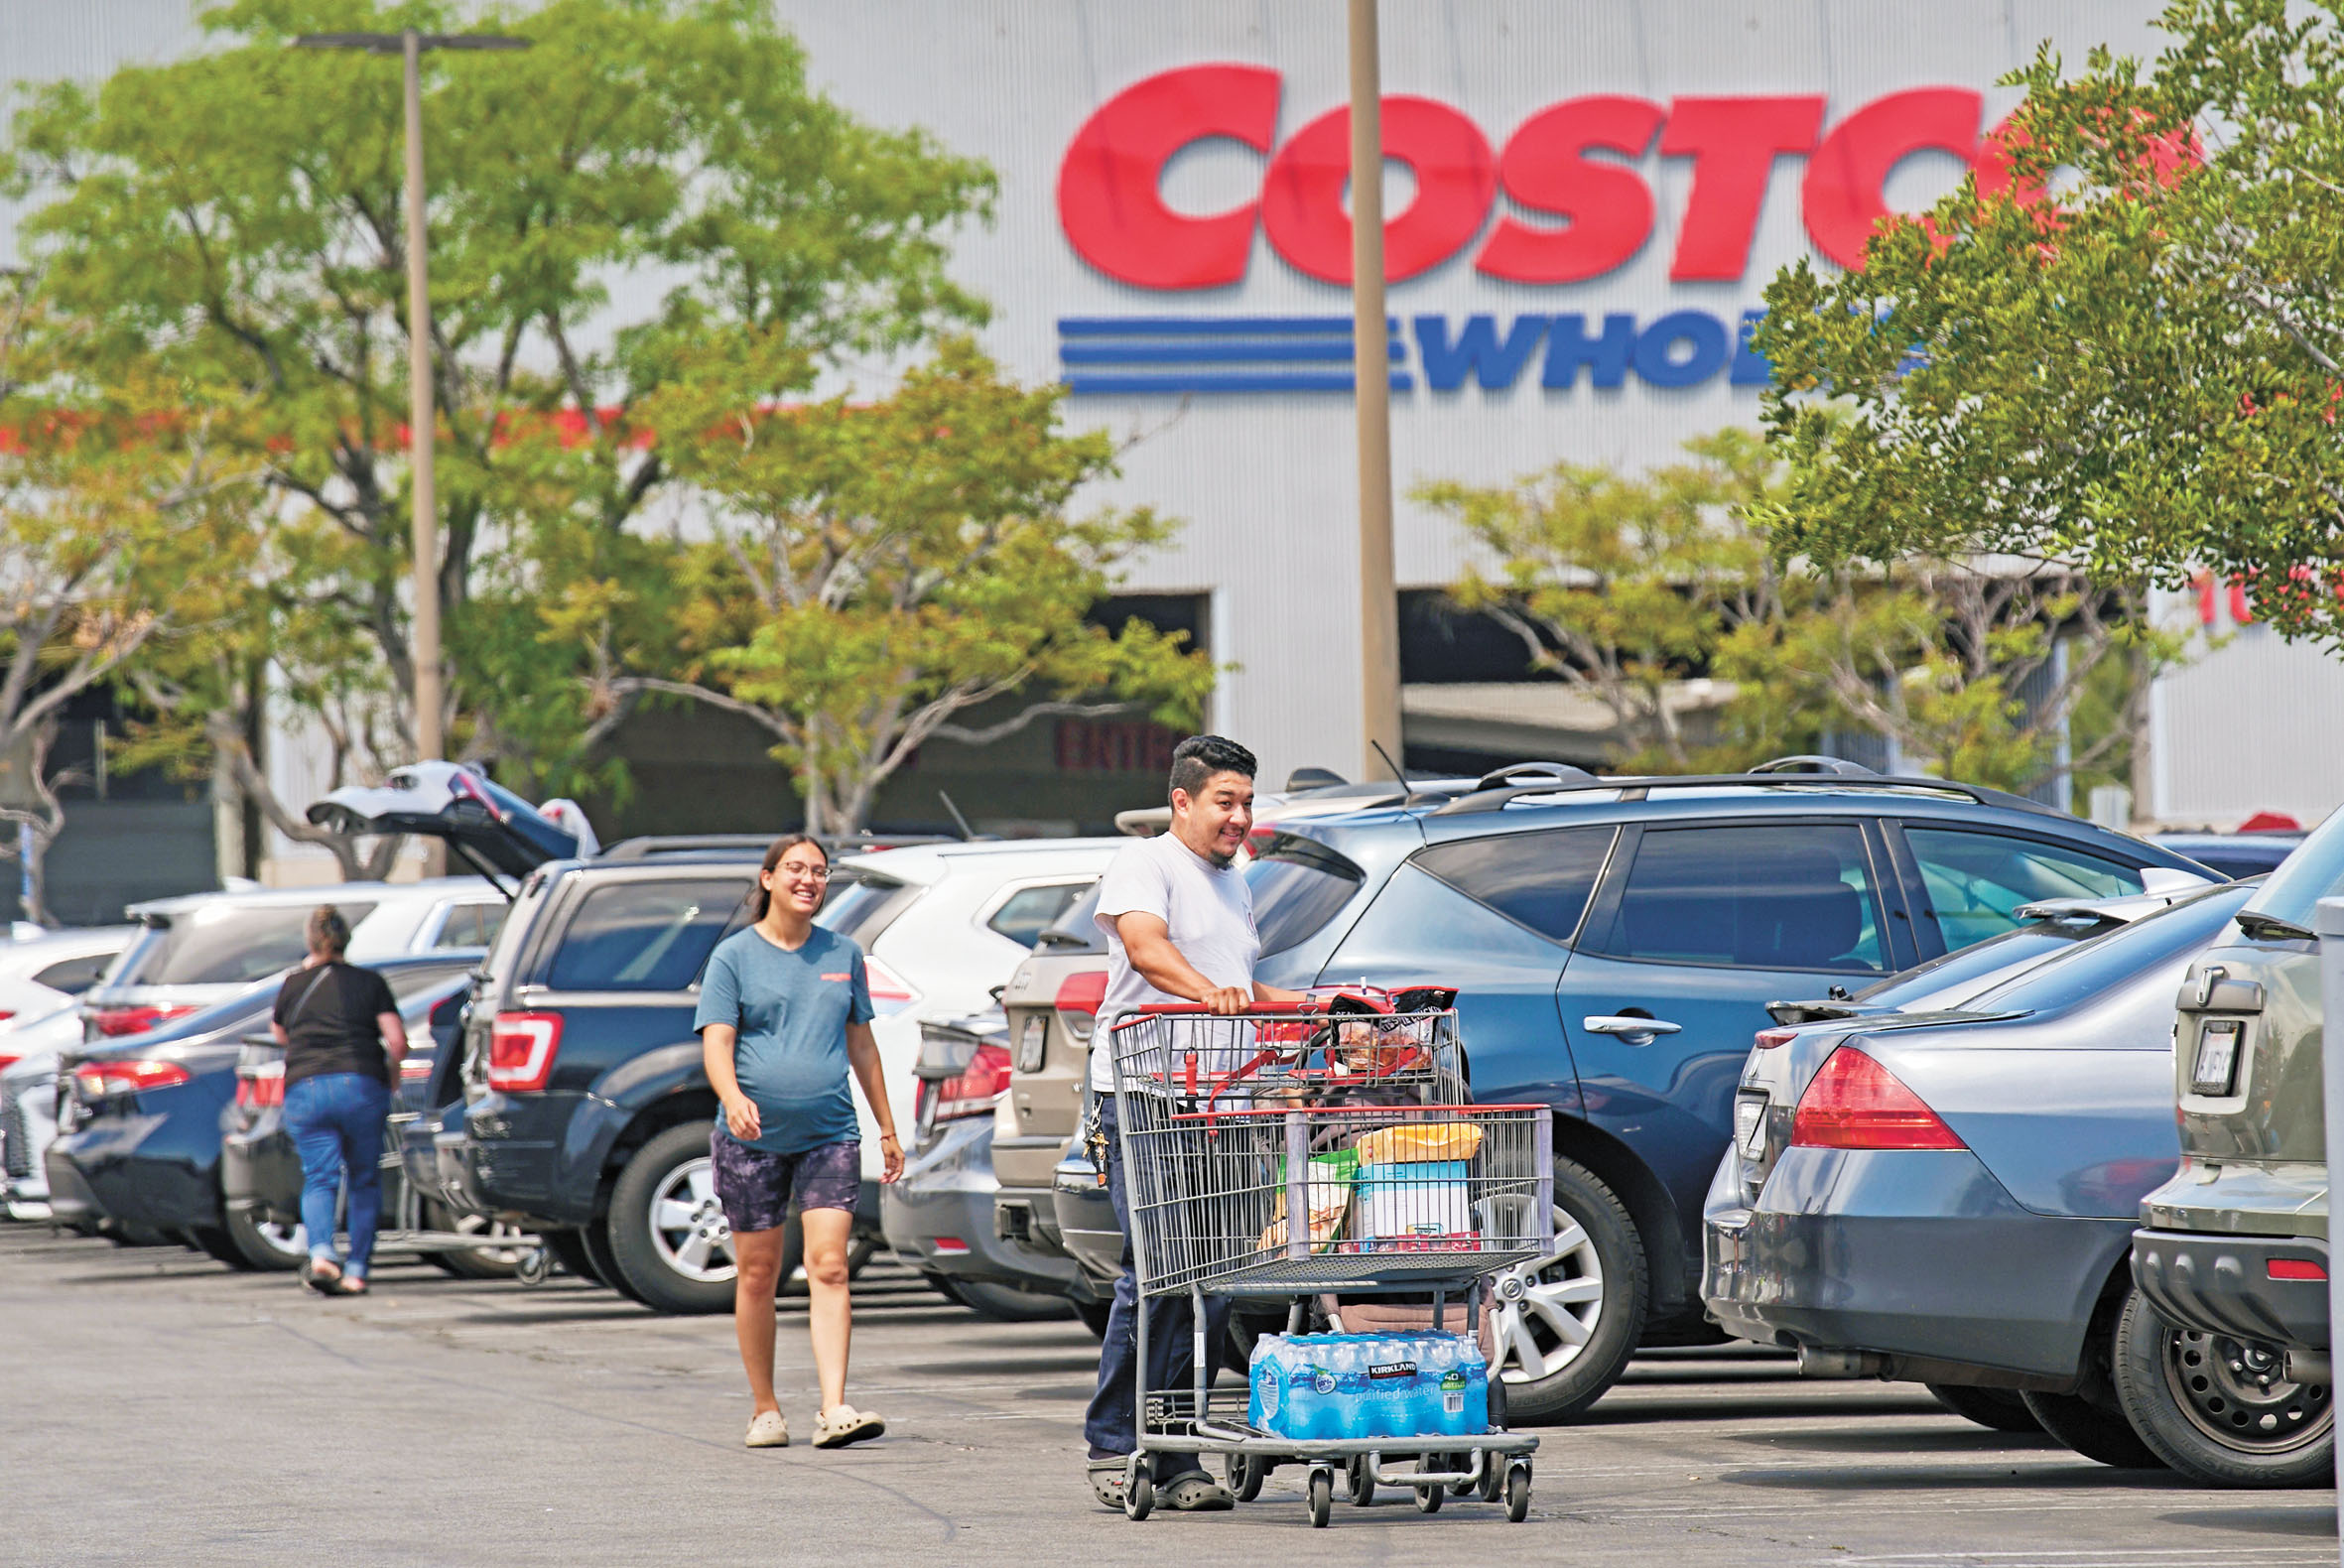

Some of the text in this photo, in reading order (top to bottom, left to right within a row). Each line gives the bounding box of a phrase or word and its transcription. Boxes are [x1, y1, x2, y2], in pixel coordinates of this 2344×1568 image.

[1413, 310, 1856, 389] WHOL
[1370, 1363, 1416, 1374] KIRKLAND
[1356, 1386, 1434, 1404] purified water
